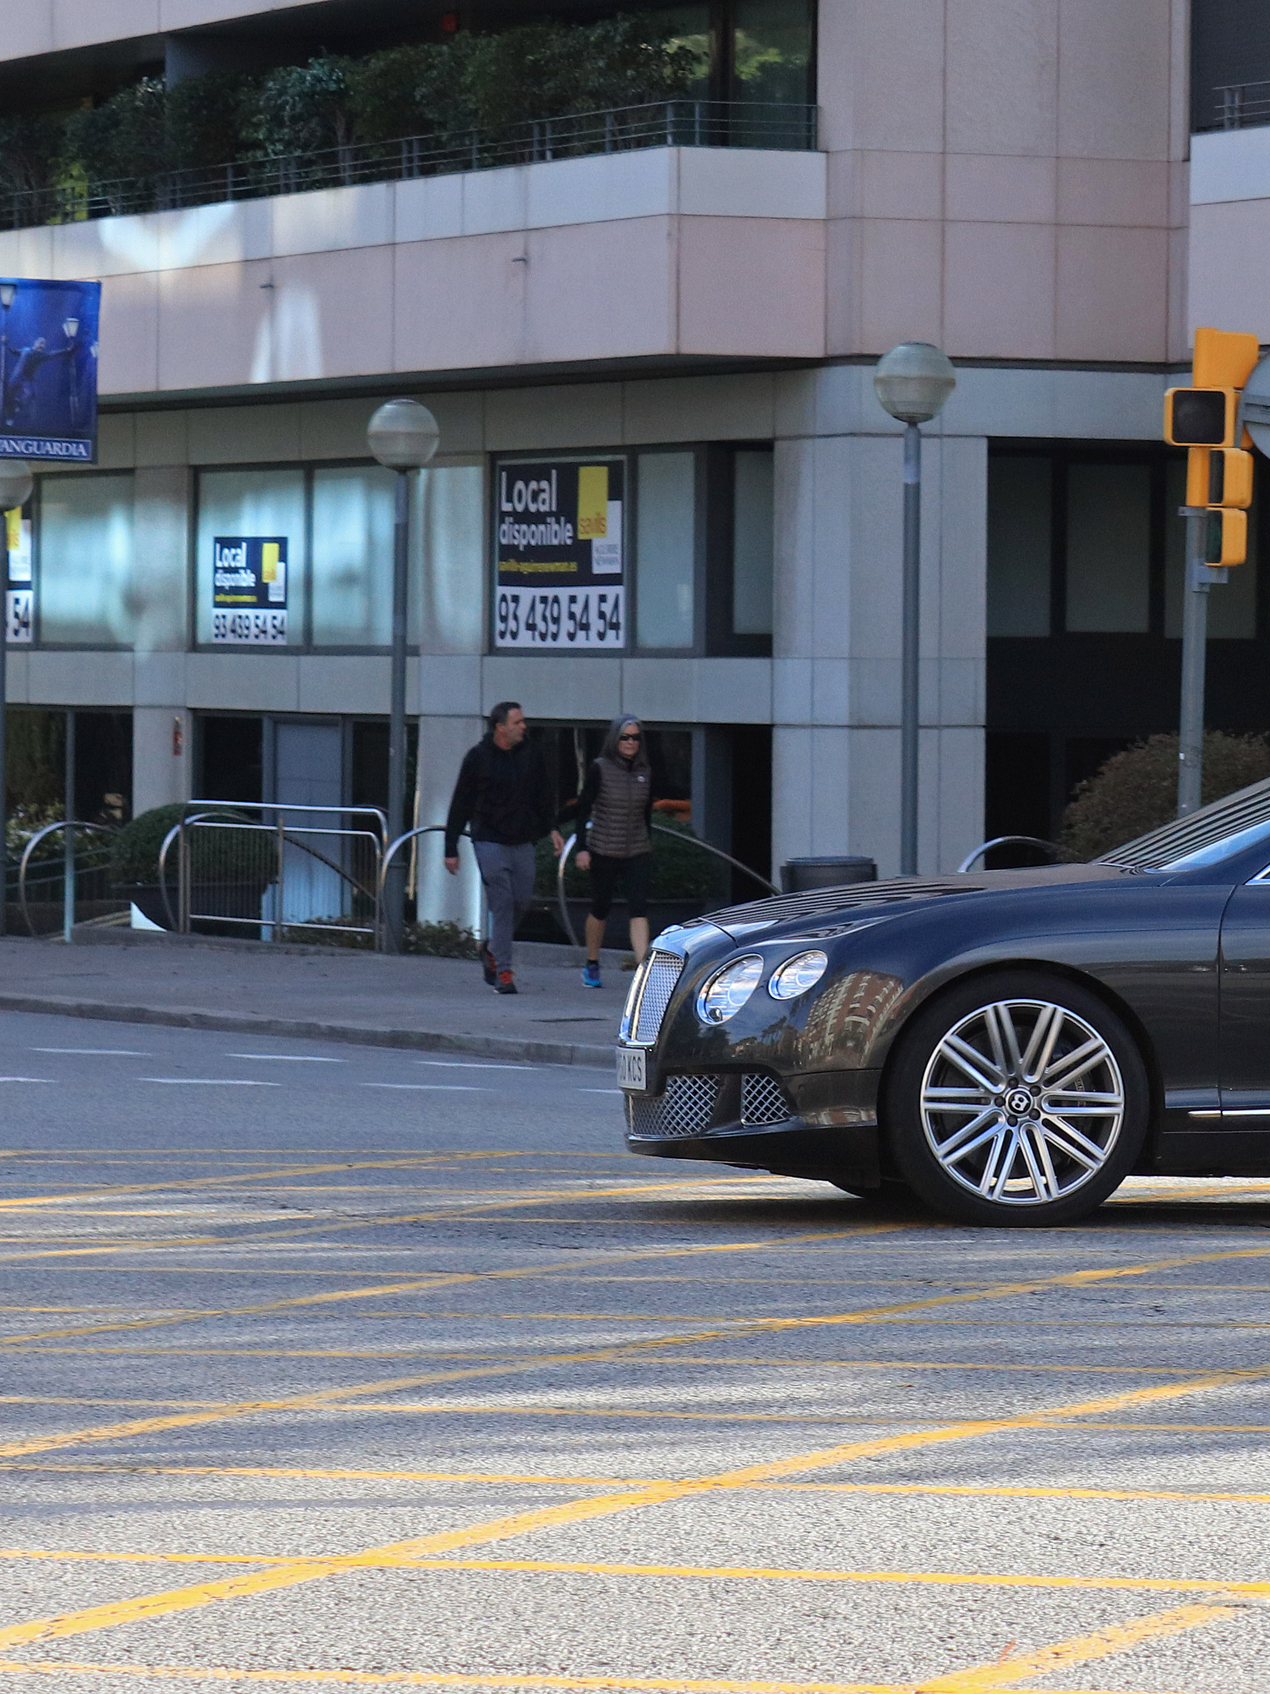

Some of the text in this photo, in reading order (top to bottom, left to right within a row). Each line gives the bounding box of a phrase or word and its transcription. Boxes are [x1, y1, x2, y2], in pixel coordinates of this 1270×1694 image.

[0, 439, 88, 456] ANGUARDIA
[501, 469, 557, 513] Local
[500, 517, 573, 551] disponible
[215, 542, 247, 568] Local
[13, 597, 31, 638] 54
[214, 614, 285, 639] 93 439 54 54
[499, 594, 621, 642] 93 439 54 54
